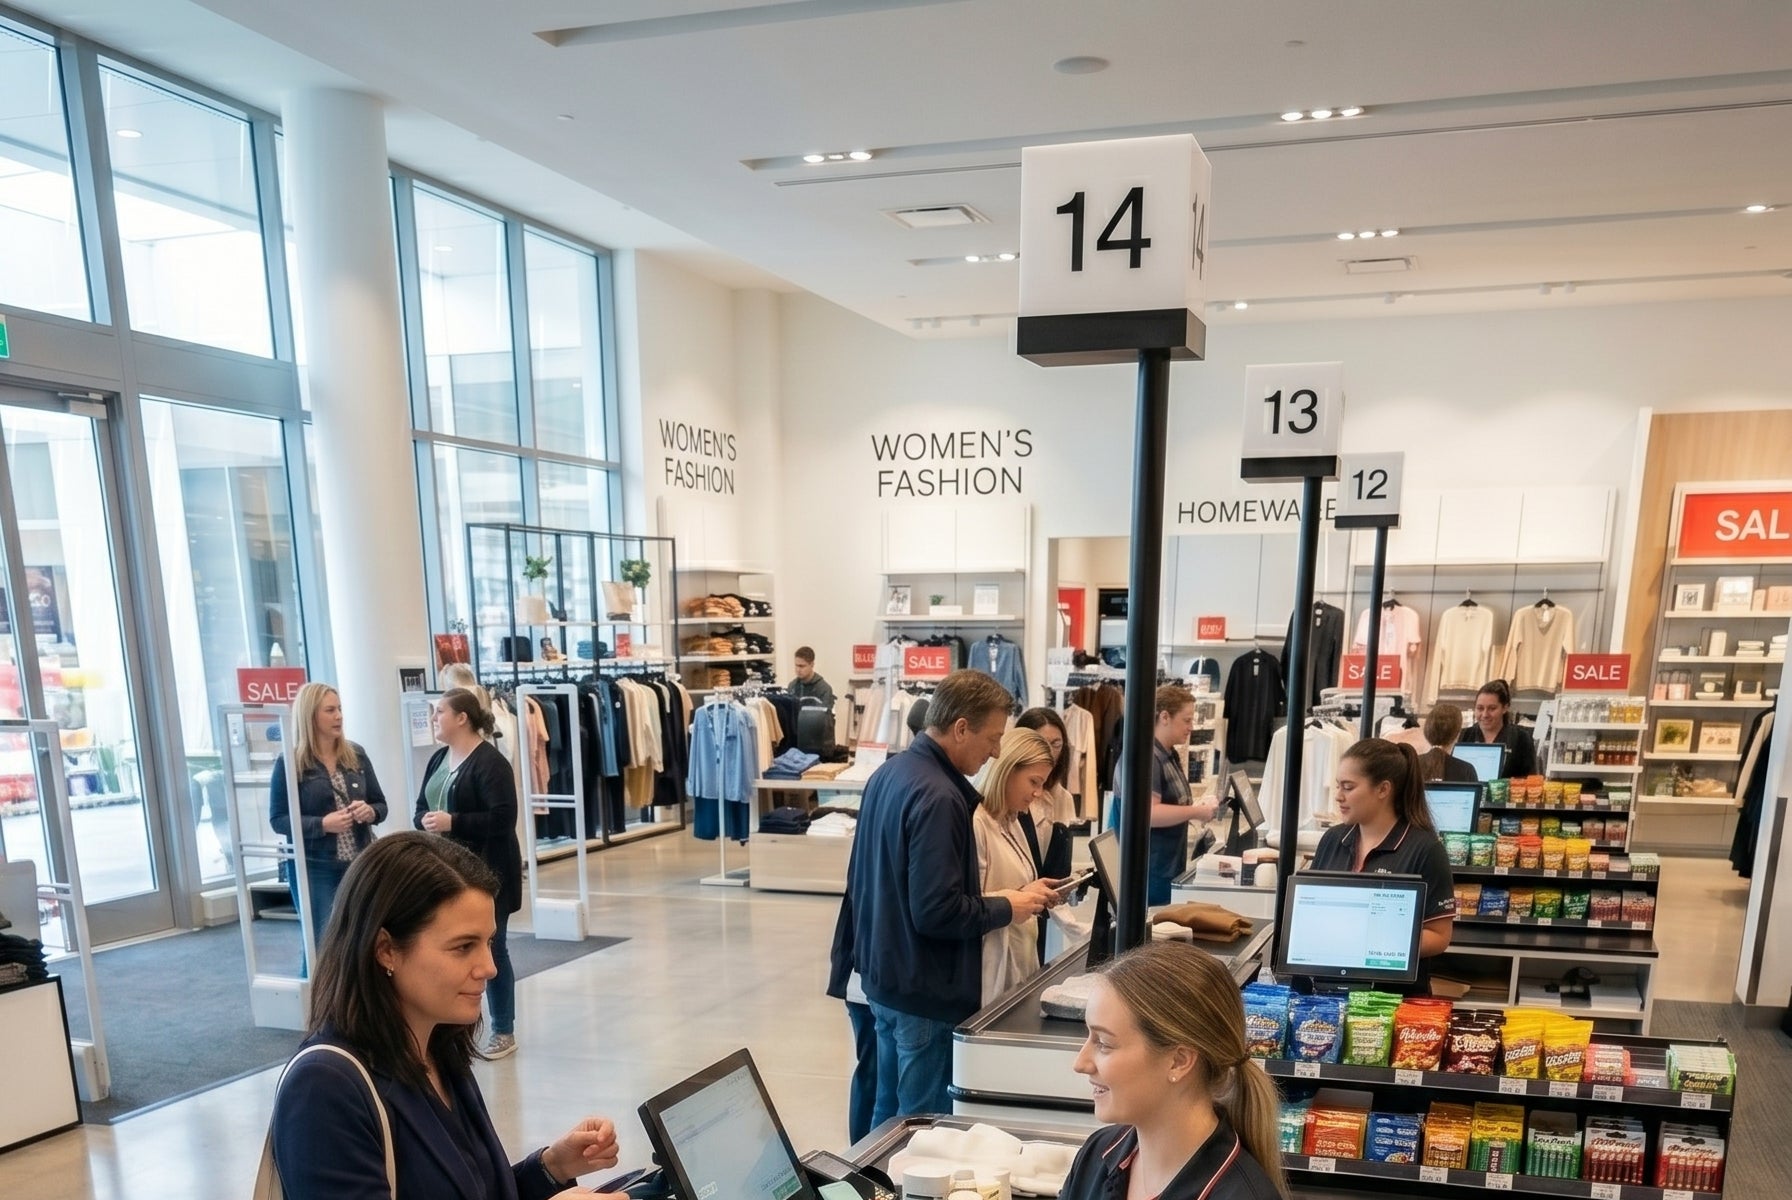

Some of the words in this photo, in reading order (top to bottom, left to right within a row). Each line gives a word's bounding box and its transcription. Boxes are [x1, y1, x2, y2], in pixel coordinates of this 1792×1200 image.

[1056, 187, 1152, 272] 14
[1192, 192, 1205, 281] 14
[1264, 389, 1318, 434] 13
[659, 418, 737, 462] WOMEN'S
[871, 429, 1033, 461] WOMEN'S
[665, 456, 735, 495] FASHION
[878, 466, 1022, 497] FASHION
[1353, 469, 1388, 500] 12
[1178, 498, 1337, 524] HOMEWAE
[1715, 509, 1791, 541] SAL
[909, 656, 945, 669] SALE
[1348, 664, 1392, 680] SE
[1572, 664, 1622, 680] SALE
[247, 682, 298, 702] SALE
